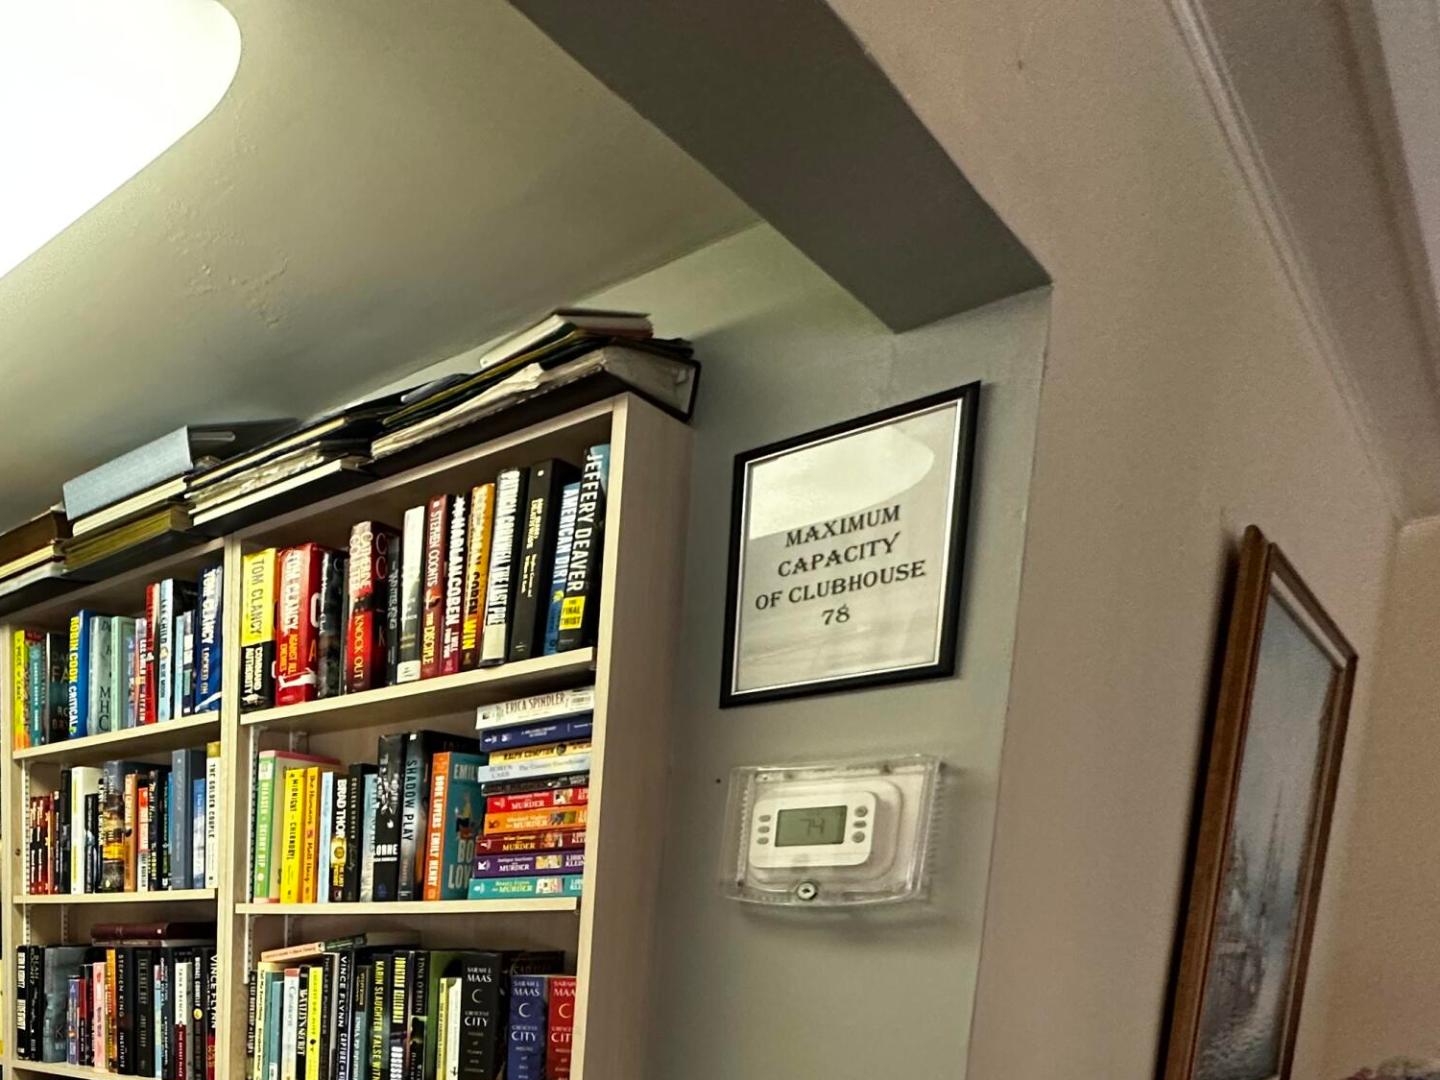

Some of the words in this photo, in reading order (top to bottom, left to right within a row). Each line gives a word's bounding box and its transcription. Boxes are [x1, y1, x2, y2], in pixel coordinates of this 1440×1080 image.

[498, 470, 520, 515] PATRICIA
[577, 453, 603, 523] JEFFERY
[428, 511, 441, 548] STEPHEN
[555, 489, 580, 555] AMERICAN
[785, 504, 901, 548] MAXIMUM
[284, 552, 300, 582] TOM
[349, 534, 361, 591] COULTER
[360, 532, 373, 588] CATHERINE
[426, 550, 438, 587] COONTS
[566, 528, 593, 593] DEAVER
[777, 532, 901, 577] CAPACITY
[250, 559, 265, 584] TOM
[490, 566, 511, 583] THE
[552, 556, 569, 585] DIRT
[755, 591, 783, 610] OF
[789, 560, 926, 604] CLUBHOUSE
[282, 584, 299, 635] CLANCY
[445, 577, 461, 626] COBEN
[489, 584, 508, 606] LAST
[202, 600, 215, 644] CLANCY
[250, 589, 263, 635] CLANCY
[822, 605, 850, 625] 78
[69, 616, 79, 651] ROBIN
[139, 639, 147, 652] LEE
[160, 617, 168, 644] CHILD
[354, 614, 364, 653] KNOCK
[423, 626, 435, 664] DISCIPLE
[462, 618, 477, 650] WIN
[69, 653, 78, 683] COOK
[201, 647, 209, 681] LOCKED
[244, 648, 254, 694] AUTHORITY
[253, 646, 264, 690] COMMAND
[354, 656, 364, 680] OUT
[200, 683, 208, 694] ON
[68, 686, 78, 727] CRITICAL
[506, 699, 527, 716] ERICA
[529, 692, 566, 710] SPINDLER
[404, 760, 418, 809] SHADOW
[433, 776, 445, 797] BOOK
[453, 763, 477, 780] EMIL
[208, 781, 216, 808] GOLDEN
[289, 778, 299, 812] MIDNIGHT
[307, 789, 315, 825] Humans
[336, 778, 347, 808] BRAD
[511, 799, 545, 809] MURDER
[335, 809, 346, 839] THOR
[402, 814, 414, 841] PLAY
[431, 799, 443, 829] LOVERS
[514, 818, 549, 828] MURDER
[429, 832, 442, 858] EMILY
[502, 841, 536, 851] MURDER
[427, 860, 439, 887] HENRY
[499, 863, 530, 872] MURDER
[499, 883, 533, 893] MURDER
[209, 954, 217, 991] VINCE
[339, 956, 347, 989] VINCE
[375, 961, 384, 985] KARIN
[416, 957, 425, 980] EDNA
[467, 974, 492, 983] MAAS
[392, 990, 405, 1024] KELLERMAN
[415, 982, 424, 1014] O'BRIEN
[513, 988, 540, 997] MAAS
[338, 993, 346, 1028] FLYNN
[373, 987, 384, 1032] SLAUGHTER
[464, 1016, 488, 1027] CITY
[339, 1033, 347, 1064] CAPTURE
[373, 1035, 383, 1059] FALSE
[511, 1031, 537, 1042] CITY
